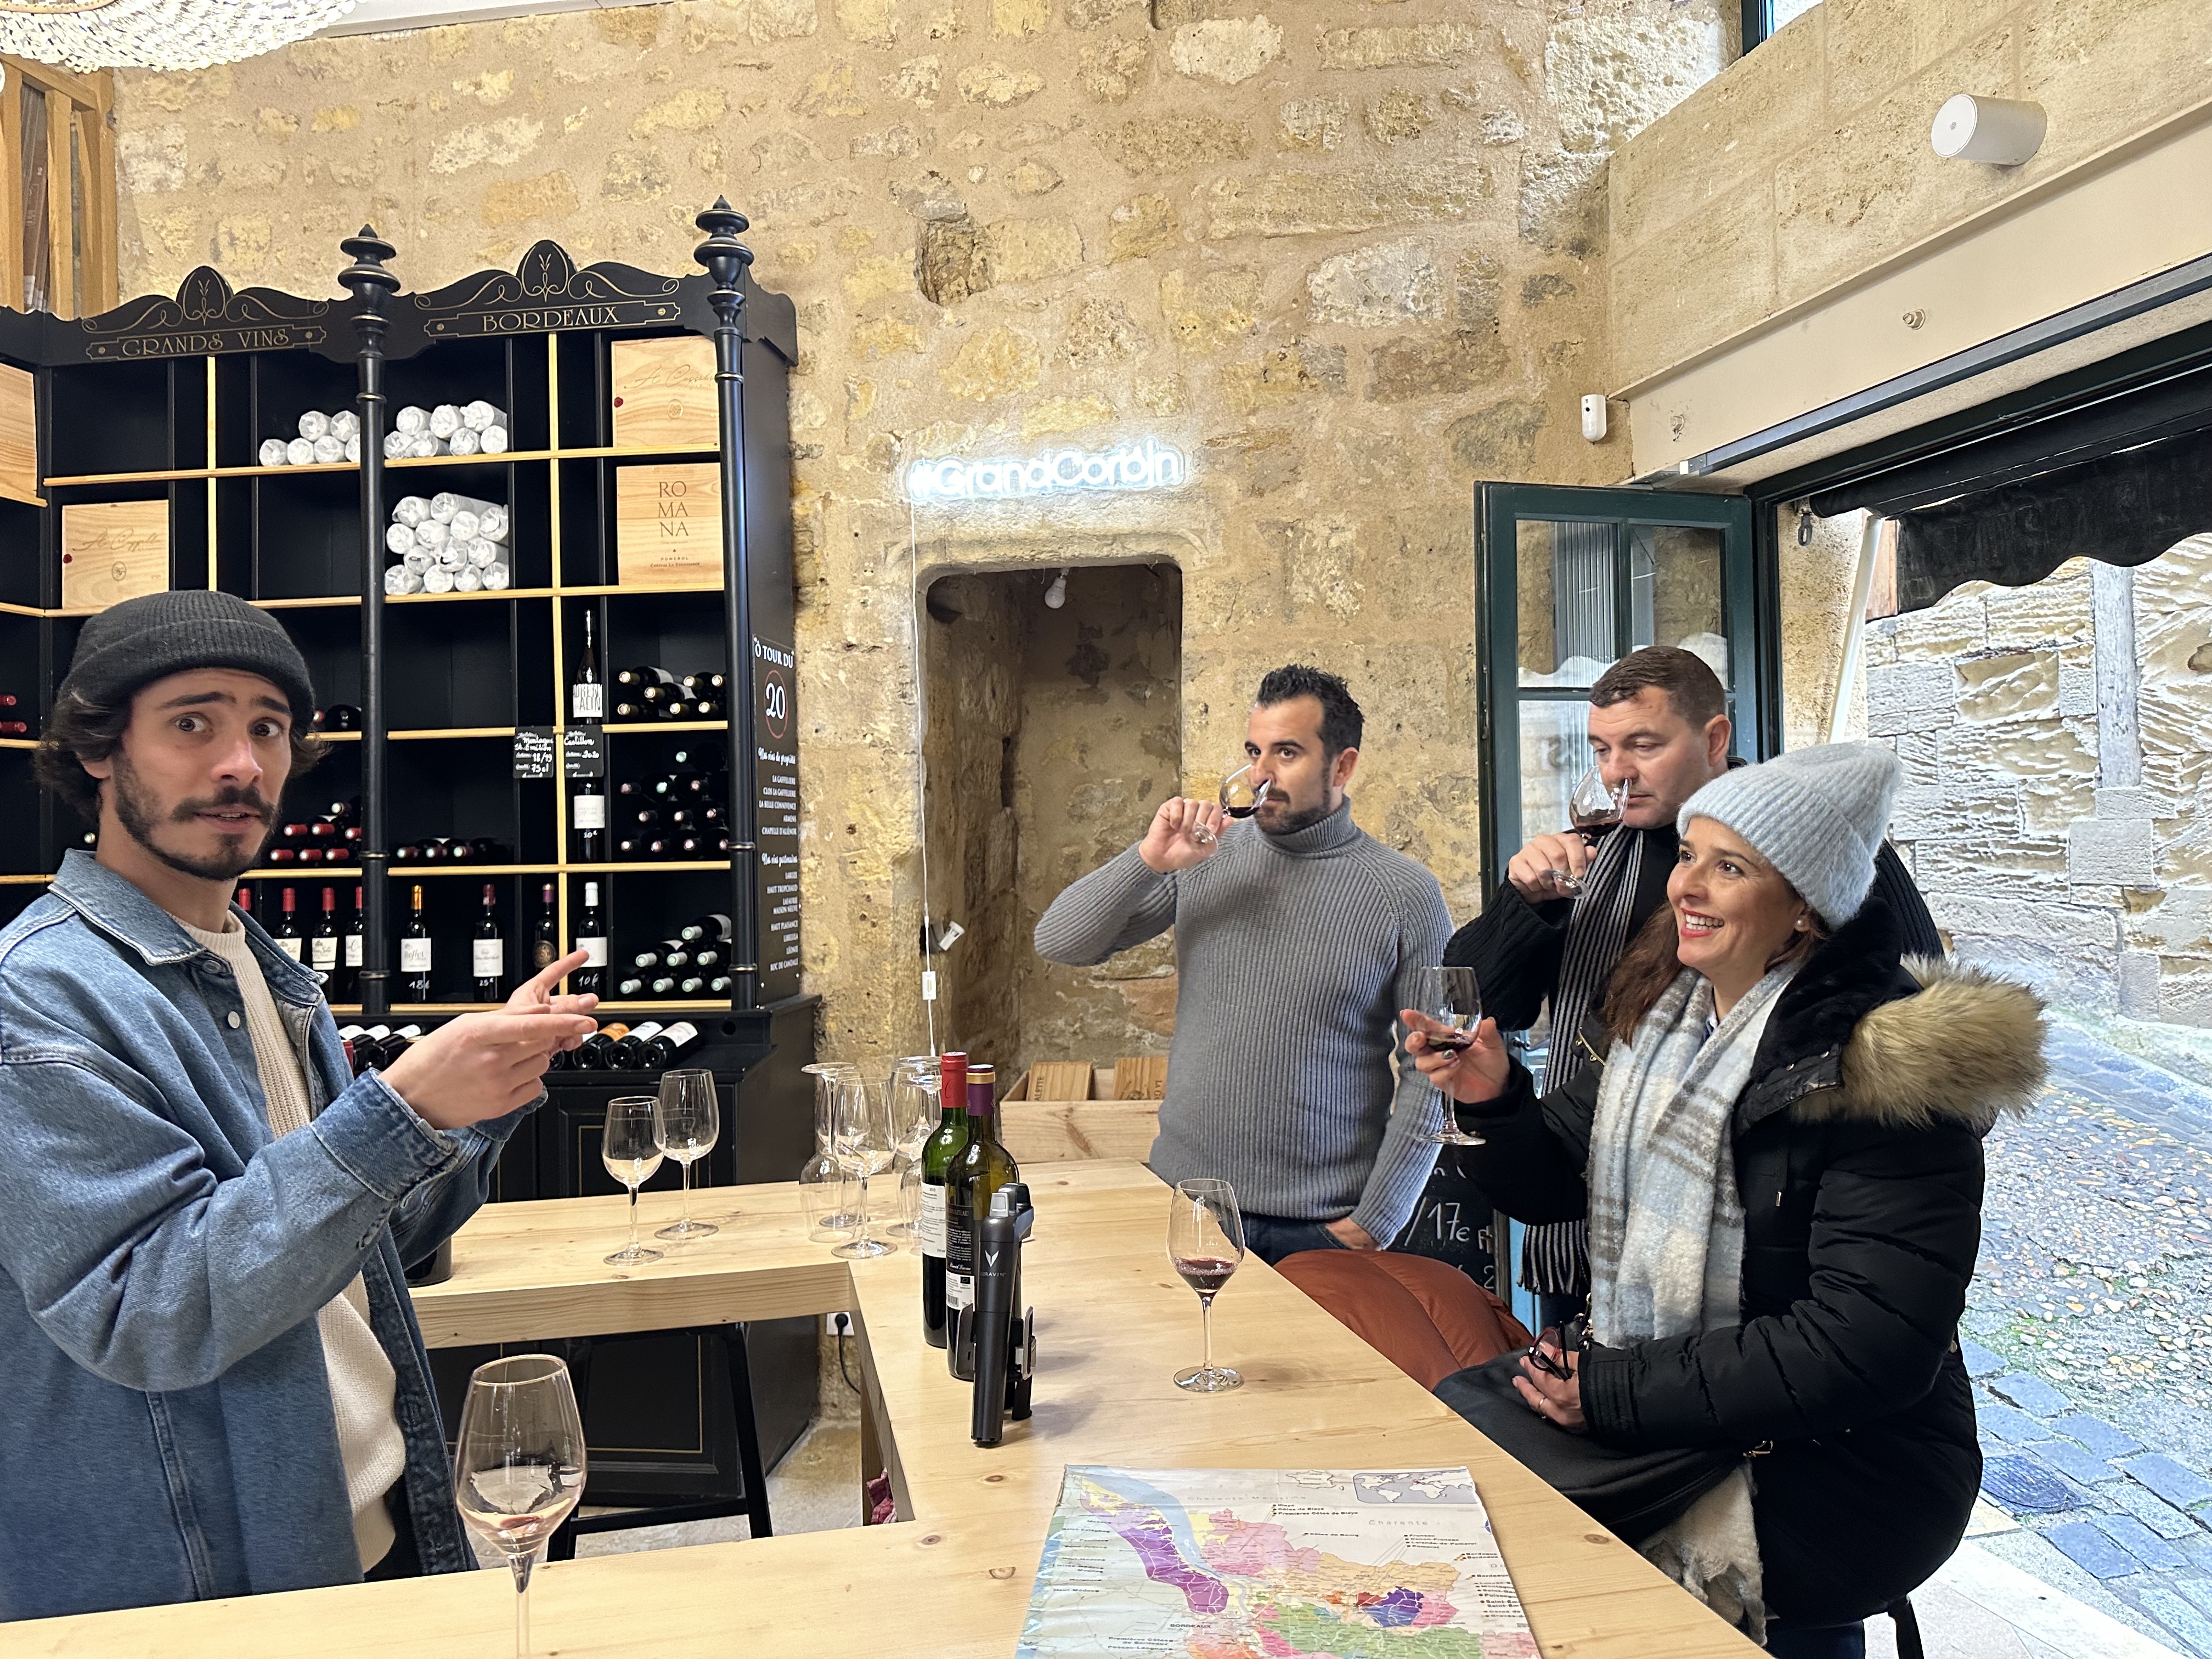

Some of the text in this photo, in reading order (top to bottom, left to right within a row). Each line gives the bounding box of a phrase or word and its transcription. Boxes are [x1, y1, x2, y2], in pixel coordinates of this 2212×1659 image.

[482, 306, 621, 332] BORDEAUX
[122, 328, 290, 357] GRANDS VINS
[659, 481, 686, 498] RO
[658, 501, 688, 518] MA
[659, 521, 689, 538] NA
[763, 645, 782, 665] TOUR
[783, 653, 793, 669] DU
[766, 682, 786, 720] 20
